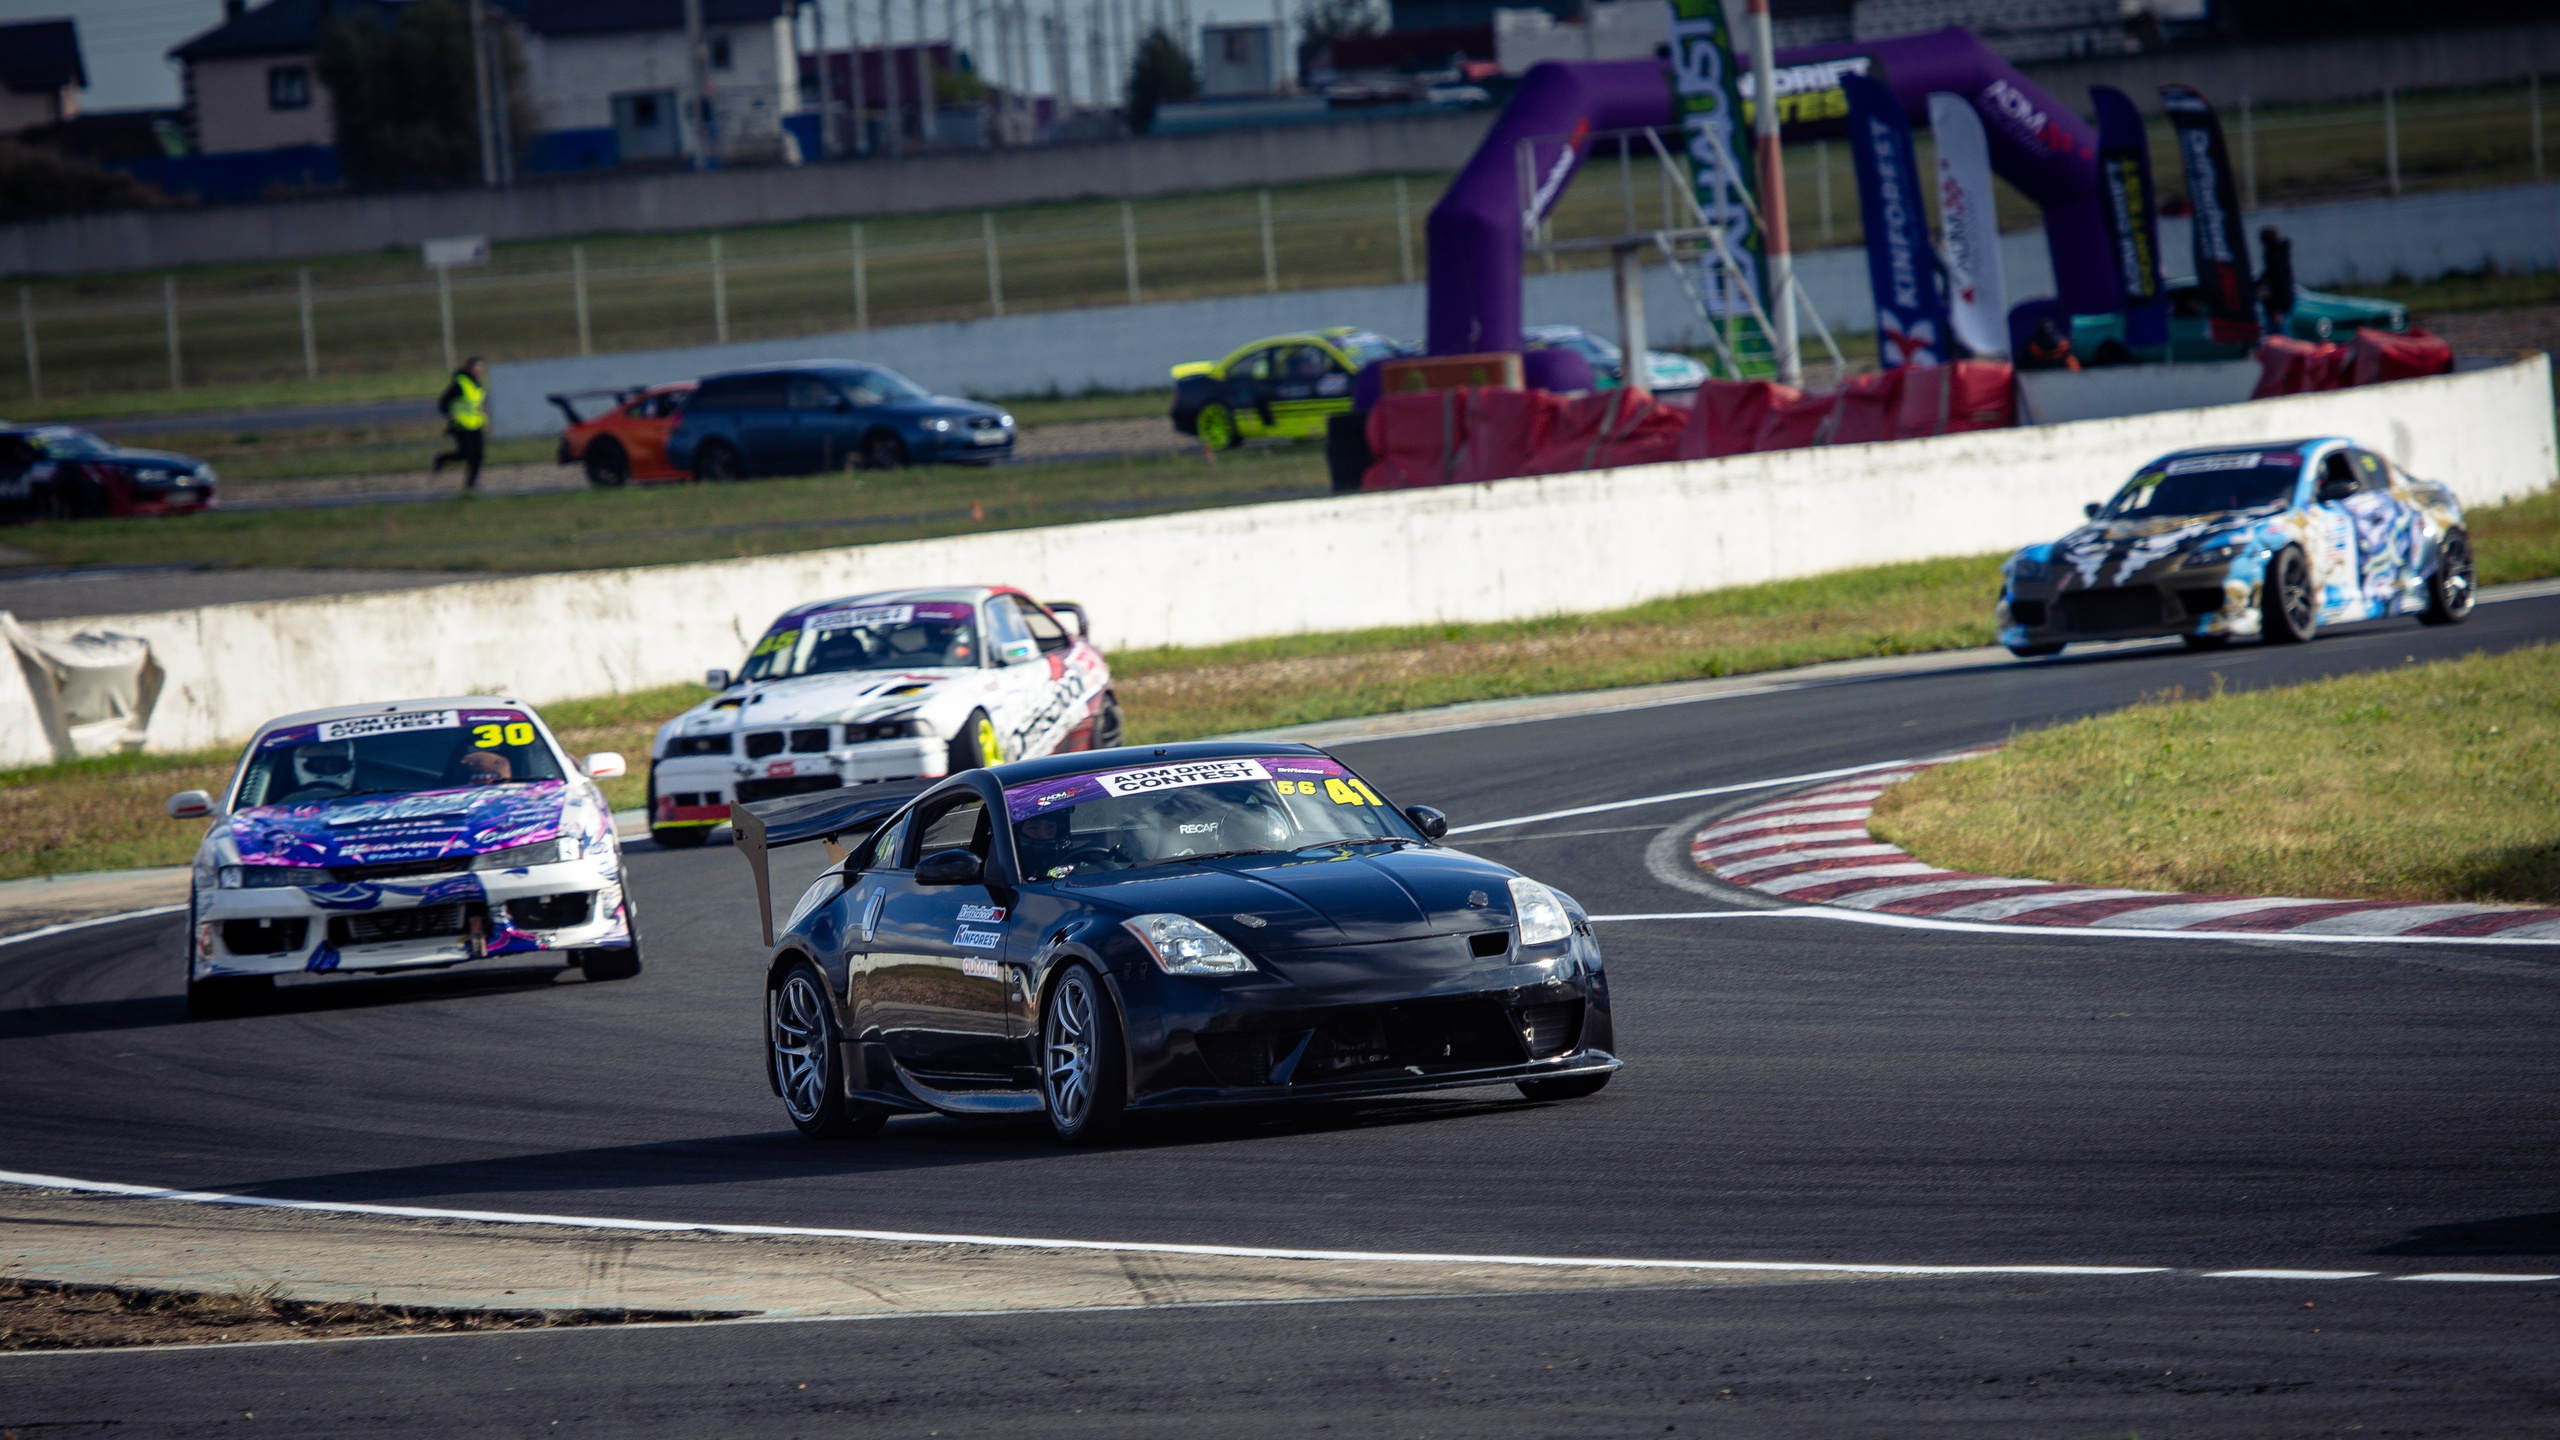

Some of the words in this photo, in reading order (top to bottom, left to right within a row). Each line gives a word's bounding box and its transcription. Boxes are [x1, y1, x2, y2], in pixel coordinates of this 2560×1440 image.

[330, 717, 379, 731] ADM
[384, 711, 444, 723] DRIFT
[330, 717, 448, 738] CONTEST
[471, 722, 535, 748] 30
[1113, 769, 1171, 784] ADM
[1174, 761, 1246, 774] DRIFT
[1118, 768, 1254, 792] CONTEST
[1324, 777, 1384, 807] 41
[1180, 822, 1219, 835] RECAR
[955, 926, 999, 947] KINFOREST
[963, 959, 998, 976] auto.ru
